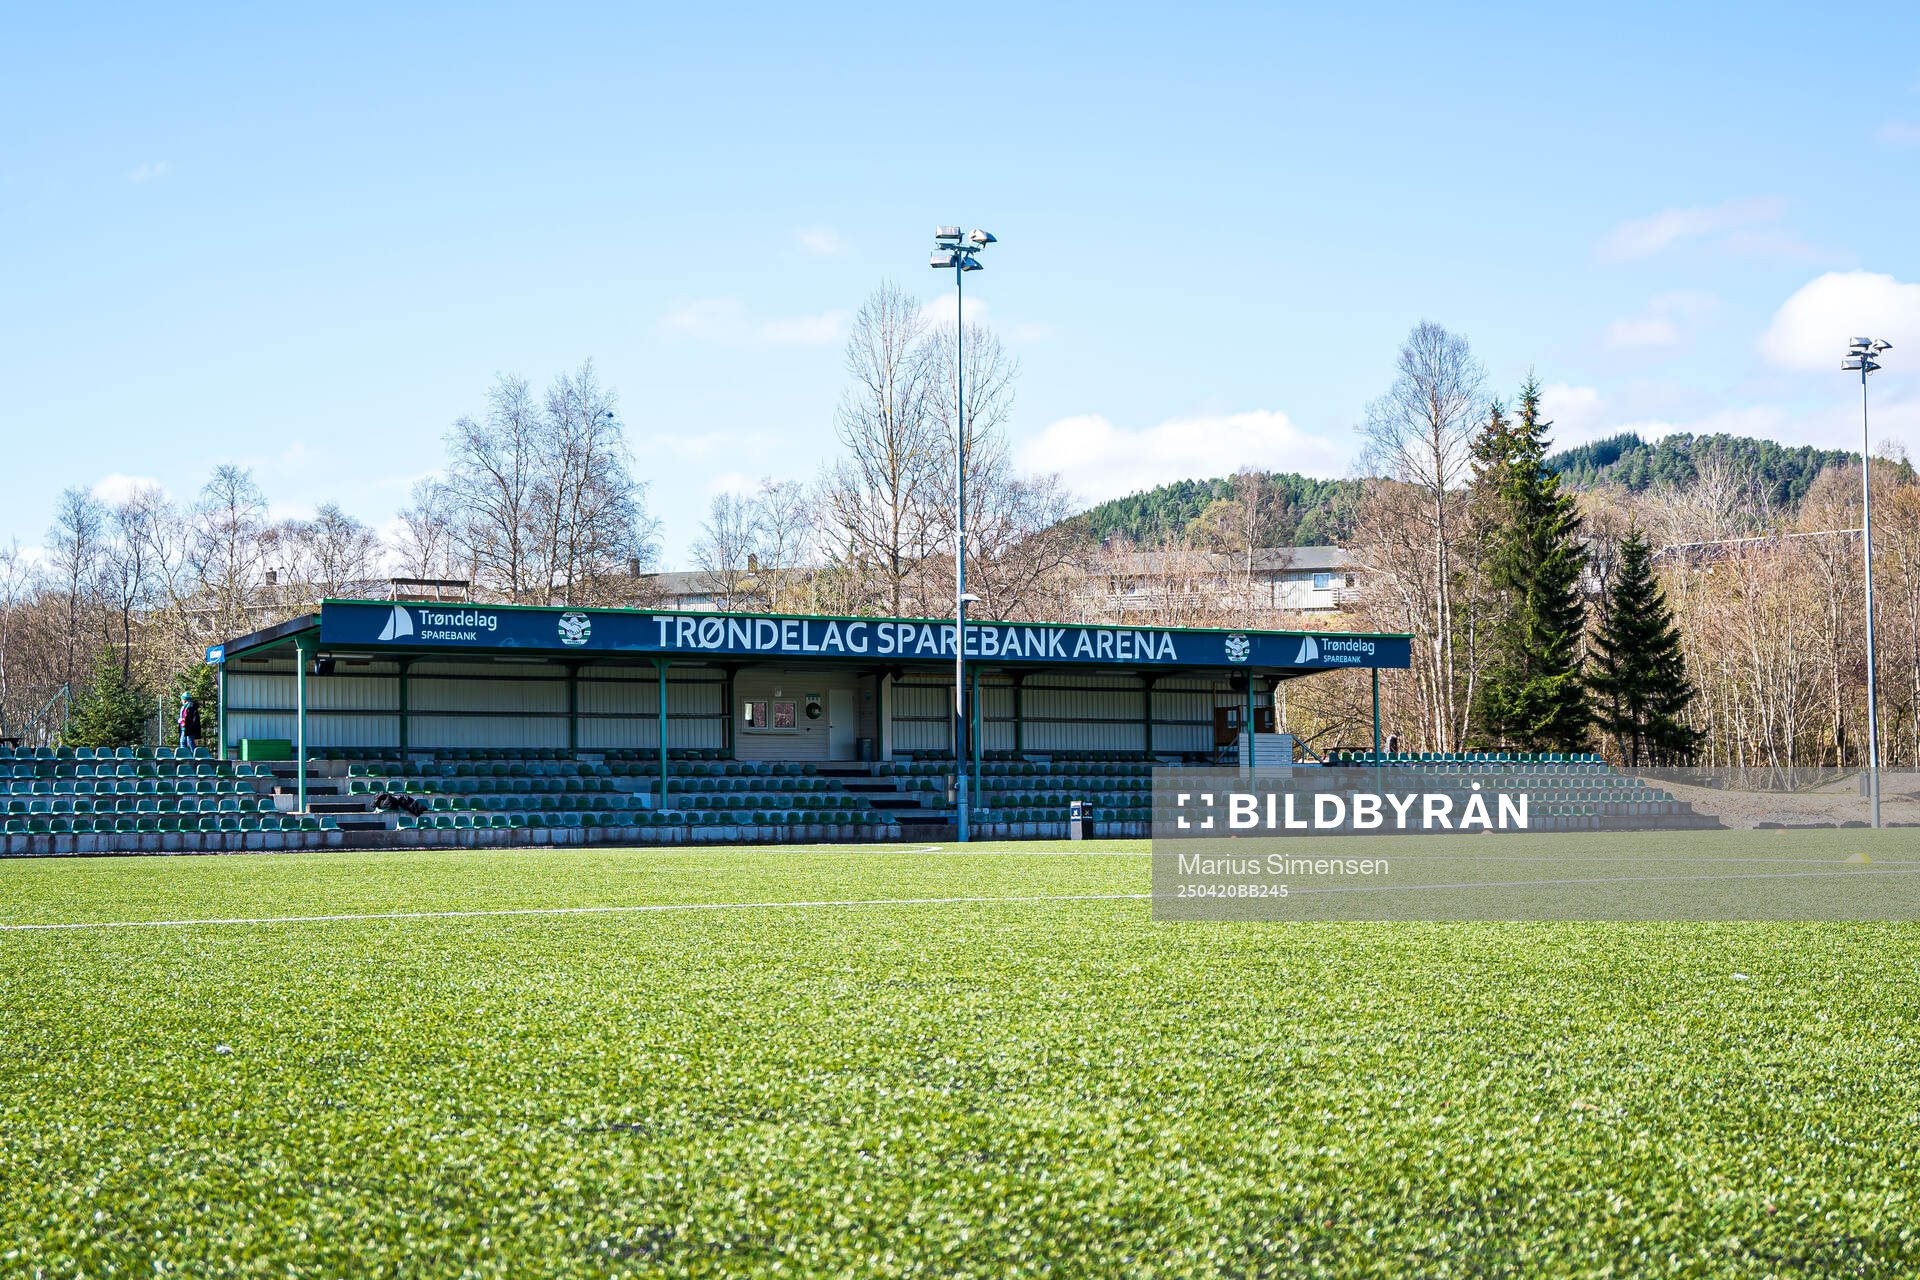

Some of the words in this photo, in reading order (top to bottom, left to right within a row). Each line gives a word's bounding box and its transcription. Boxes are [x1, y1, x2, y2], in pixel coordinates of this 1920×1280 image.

[418, 610, 497, 631] Trøndelag
[421, 630, 477, 641] SPAREBANK
[652, 615, 868, 653] TRØNDELAG
[877, 622, 1067, 658] SPAREBANK
[1074, 629, 1178, 661] ARENA
[1321, 638, 1375, 655] Trøndelag
[1323, 655, 1361, 663] SPAREBANK
